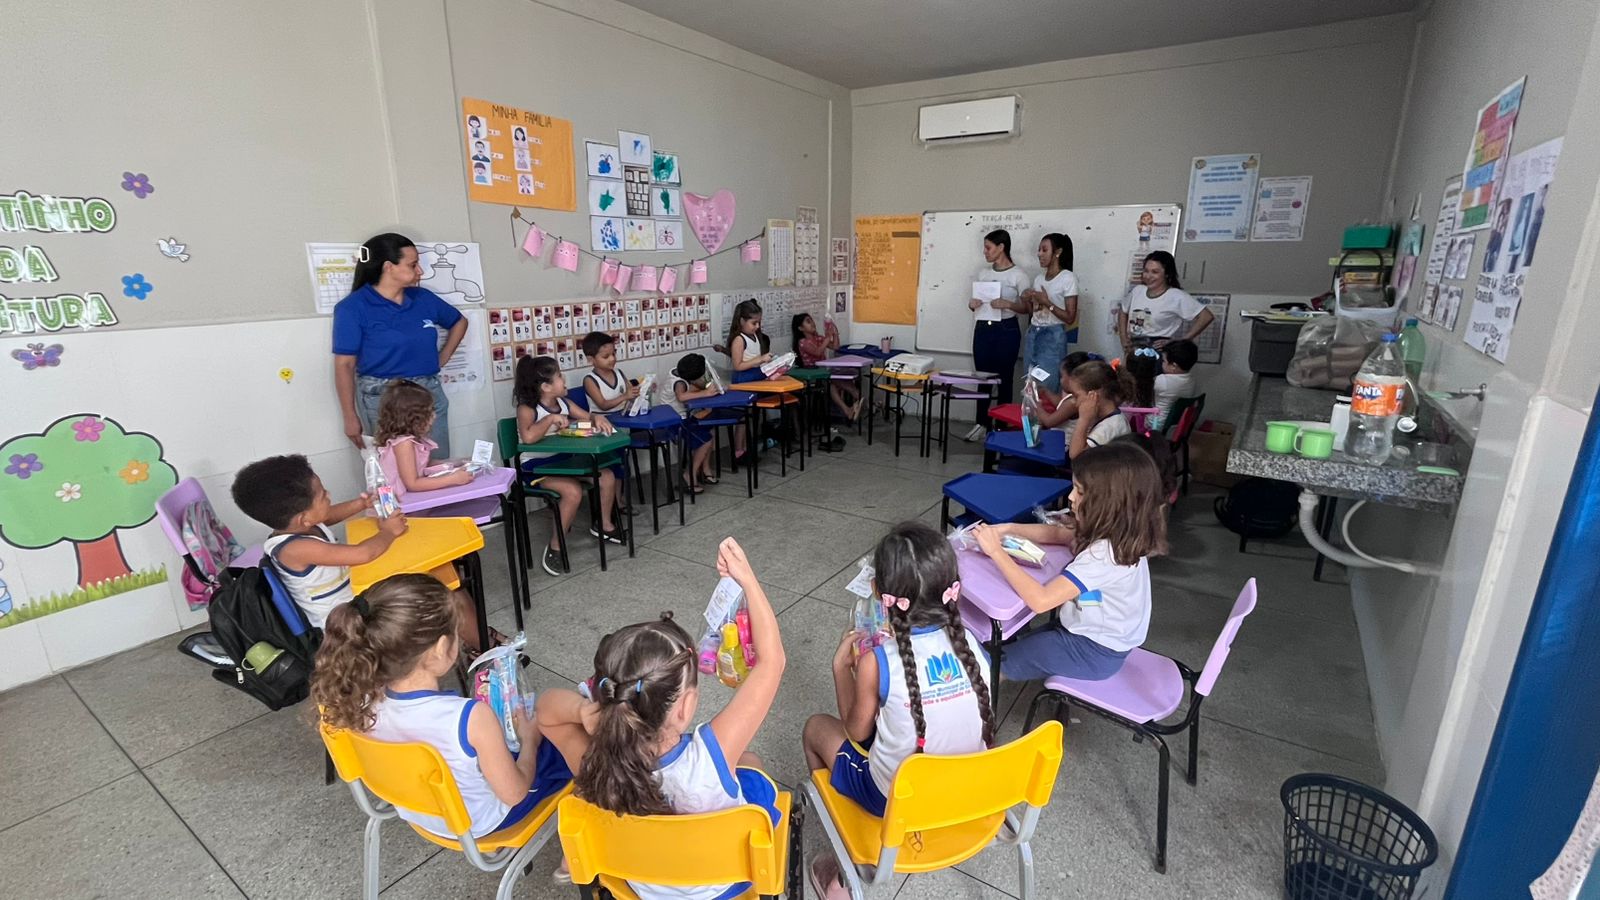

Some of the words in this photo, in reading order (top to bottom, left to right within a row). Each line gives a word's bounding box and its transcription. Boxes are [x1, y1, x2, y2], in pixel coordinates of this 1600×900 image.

[492, 104, 518, 120] MINHA
[0, 246, 60, 283] DA
[492, 328, 499, 336] A
[515, 326, 521, 334] B
[536, 324, 542, 332] C
[1356, 384, 1383, 397] FANTA
